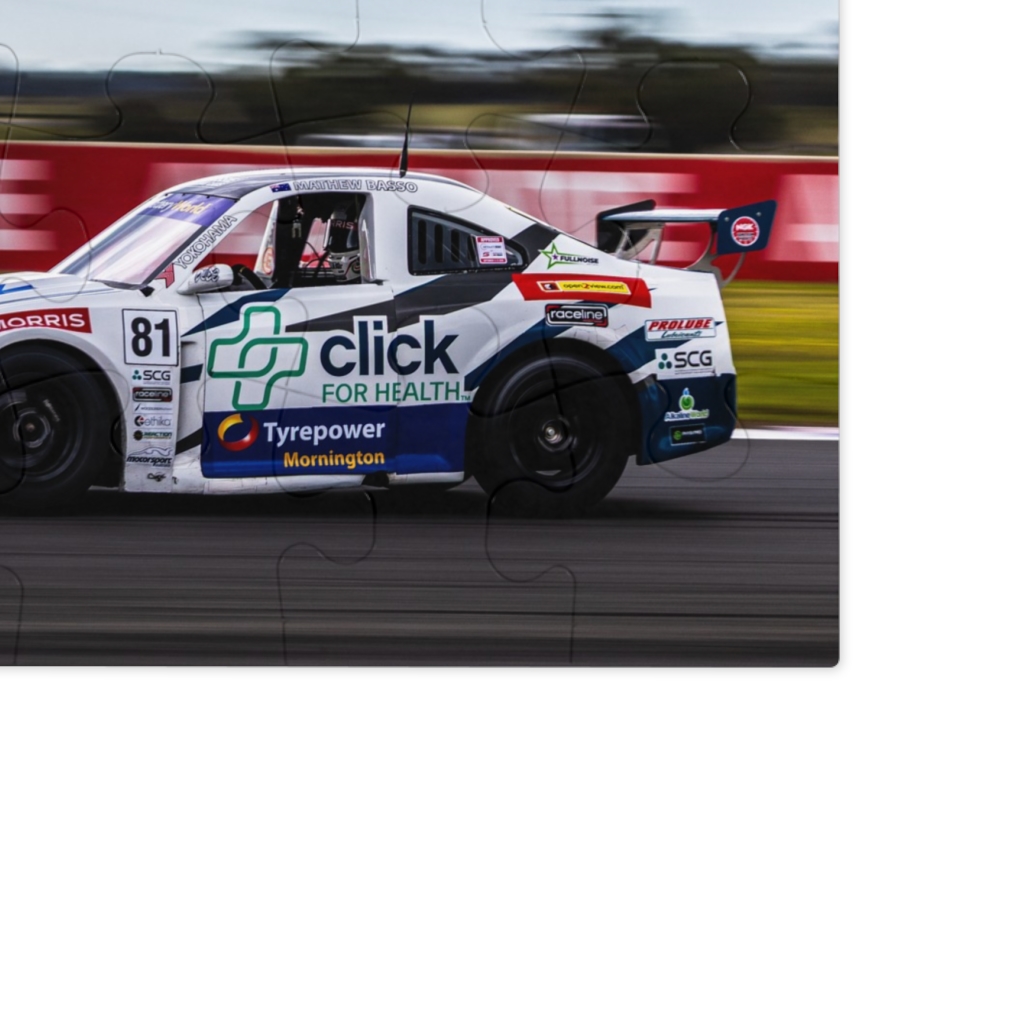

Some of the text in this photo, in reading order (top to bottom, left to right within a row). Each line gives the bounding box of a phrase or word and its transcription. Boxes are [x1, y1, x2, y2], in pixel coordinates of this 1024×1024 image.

[293, 179, 418, 193] MATHEW BASSO
[175, 215, 238, 270] YOKOHAMA
[560, 255, 599, 264] FULLNOISE
[550, 309, 603, 319] raceline
[648, 319, 712, 331] PROLUBE
[131, 317, 171, 357] 81
[320, 320, 459, 377] click
[674, 350, 712, 368] SCG
[143, 370, 171, 381] SCG
[322, 383, 367, 402] FOR
[376, 382, 460, 402] HEALTH
[263, 421, 385, 445] Tyrepower
[283, 451, 385, 469] Mornington
